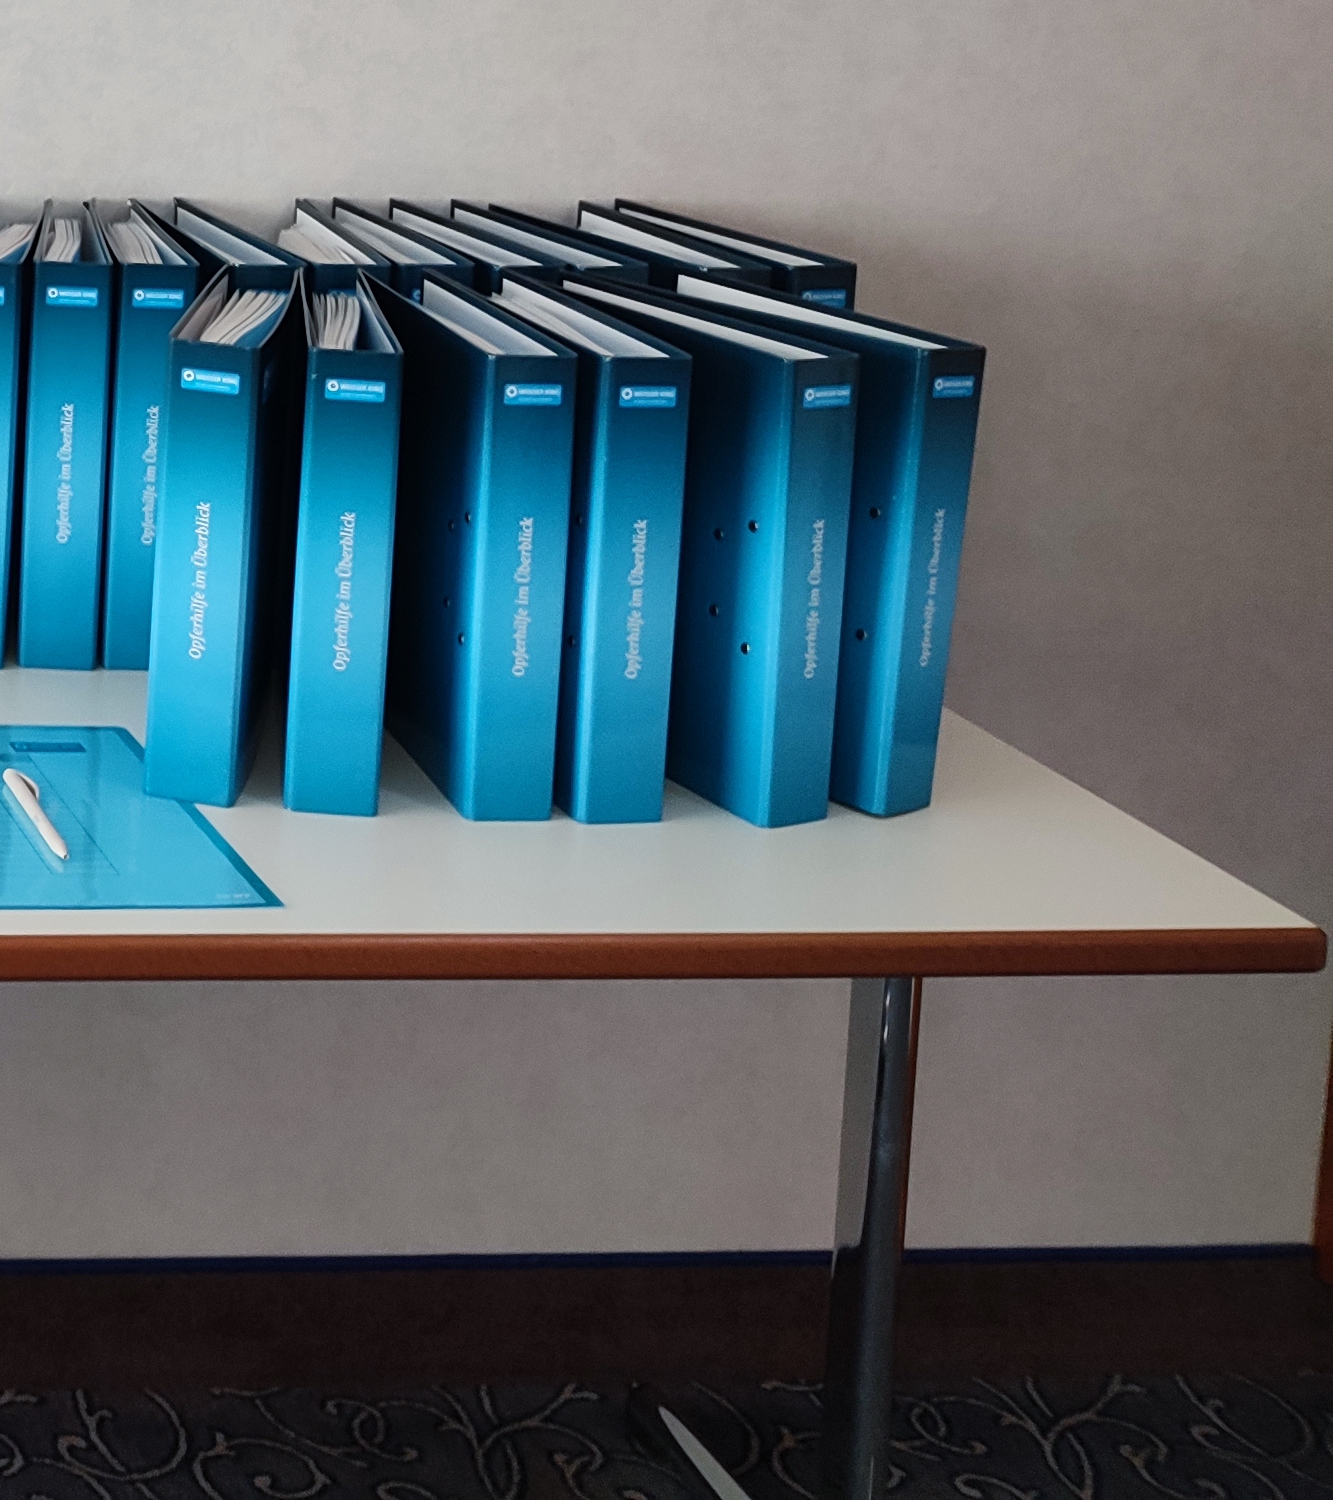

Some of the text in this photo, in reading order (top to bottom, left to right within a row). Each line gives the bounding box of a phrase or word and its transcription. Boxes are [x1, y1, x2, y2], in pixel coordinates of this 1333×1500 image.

[56, 402, 74, 544] Opferhilfe im Überblick
[141, 405, 159, 545] Opferhilfe im Überblick
[189, 501, 210, 660] Opferhilfe im Überblick
[333, 511, 356, 671] Opferhilfe im Überblick
[512, 517, 533, 677] Opferhilfe im Überblick
[624, 519, 647, 679] Opferhilfe im Überblick
[804, 519, 824, 678] Opferhilfe im Überblick
[919, 508, 945, 667] Opferhilfe im Überblick
